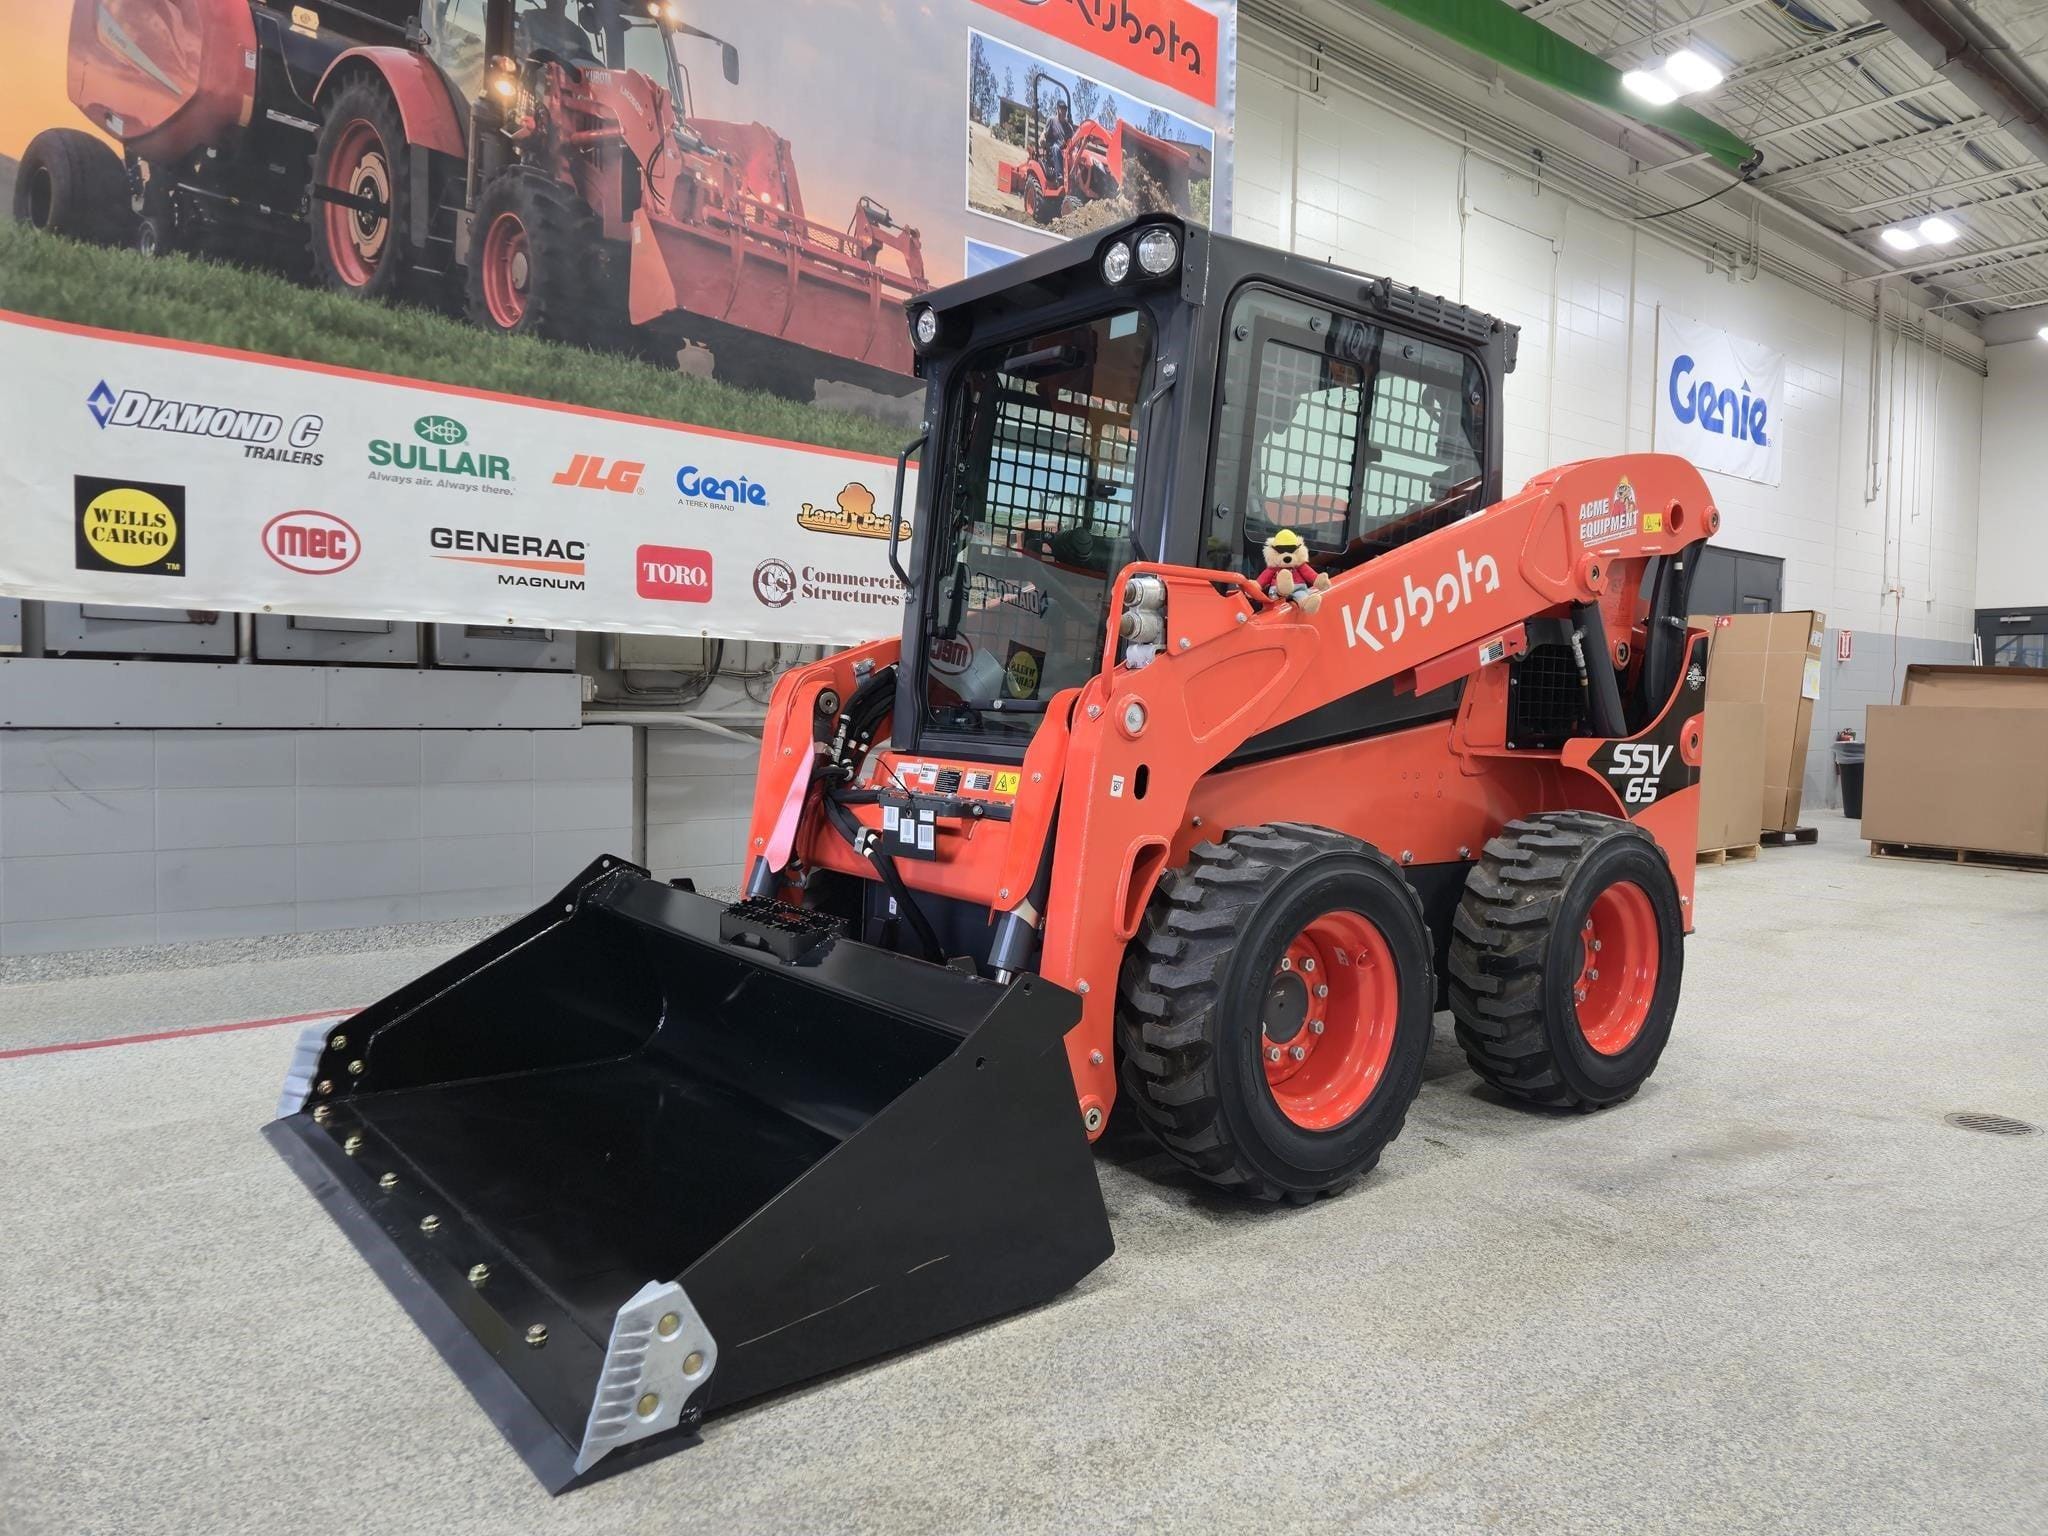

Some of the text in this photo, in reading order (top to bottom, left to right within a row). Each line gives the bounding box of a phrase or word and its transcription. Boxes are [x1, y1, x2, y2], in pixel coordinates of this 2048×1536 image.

[1669, 354, 1767, 447] Genie
[108, 389, 324, 448] DIAMOND C
[243, 444, 325, 466] TRAILERS
[367, 438, 510, 481] SULLAIR
[367, 471, 514, 496] Always air. Always there.
[551, 453, 646, 494] JLG
[676, 465, 767, 507] Genie
[93, 507, 167, 529] WELLS
[685, 499, 708, 509] TEREX
[709, 502, 735, 512] BRAND
[1580, 498, 1610, 521] ACME
[861, 511, 912, 535] Prie
[1580, 510, 1639, 540] EQUIPMENT
[91, 526, 169, 547] CARGO
[430, 527, 586, 561] GENERAC
[497, 574, 585, 591] MAGNUM
[643, 562, 705, 586] TORO
[801, 566, 907, 590] Commercia
[801, 583, 900, 606] Structures
[1341, 548, 1500, 652] Kubota
[1608, 743, 1674, 776] SSV
[1625, 777, 1660, 803] 65
